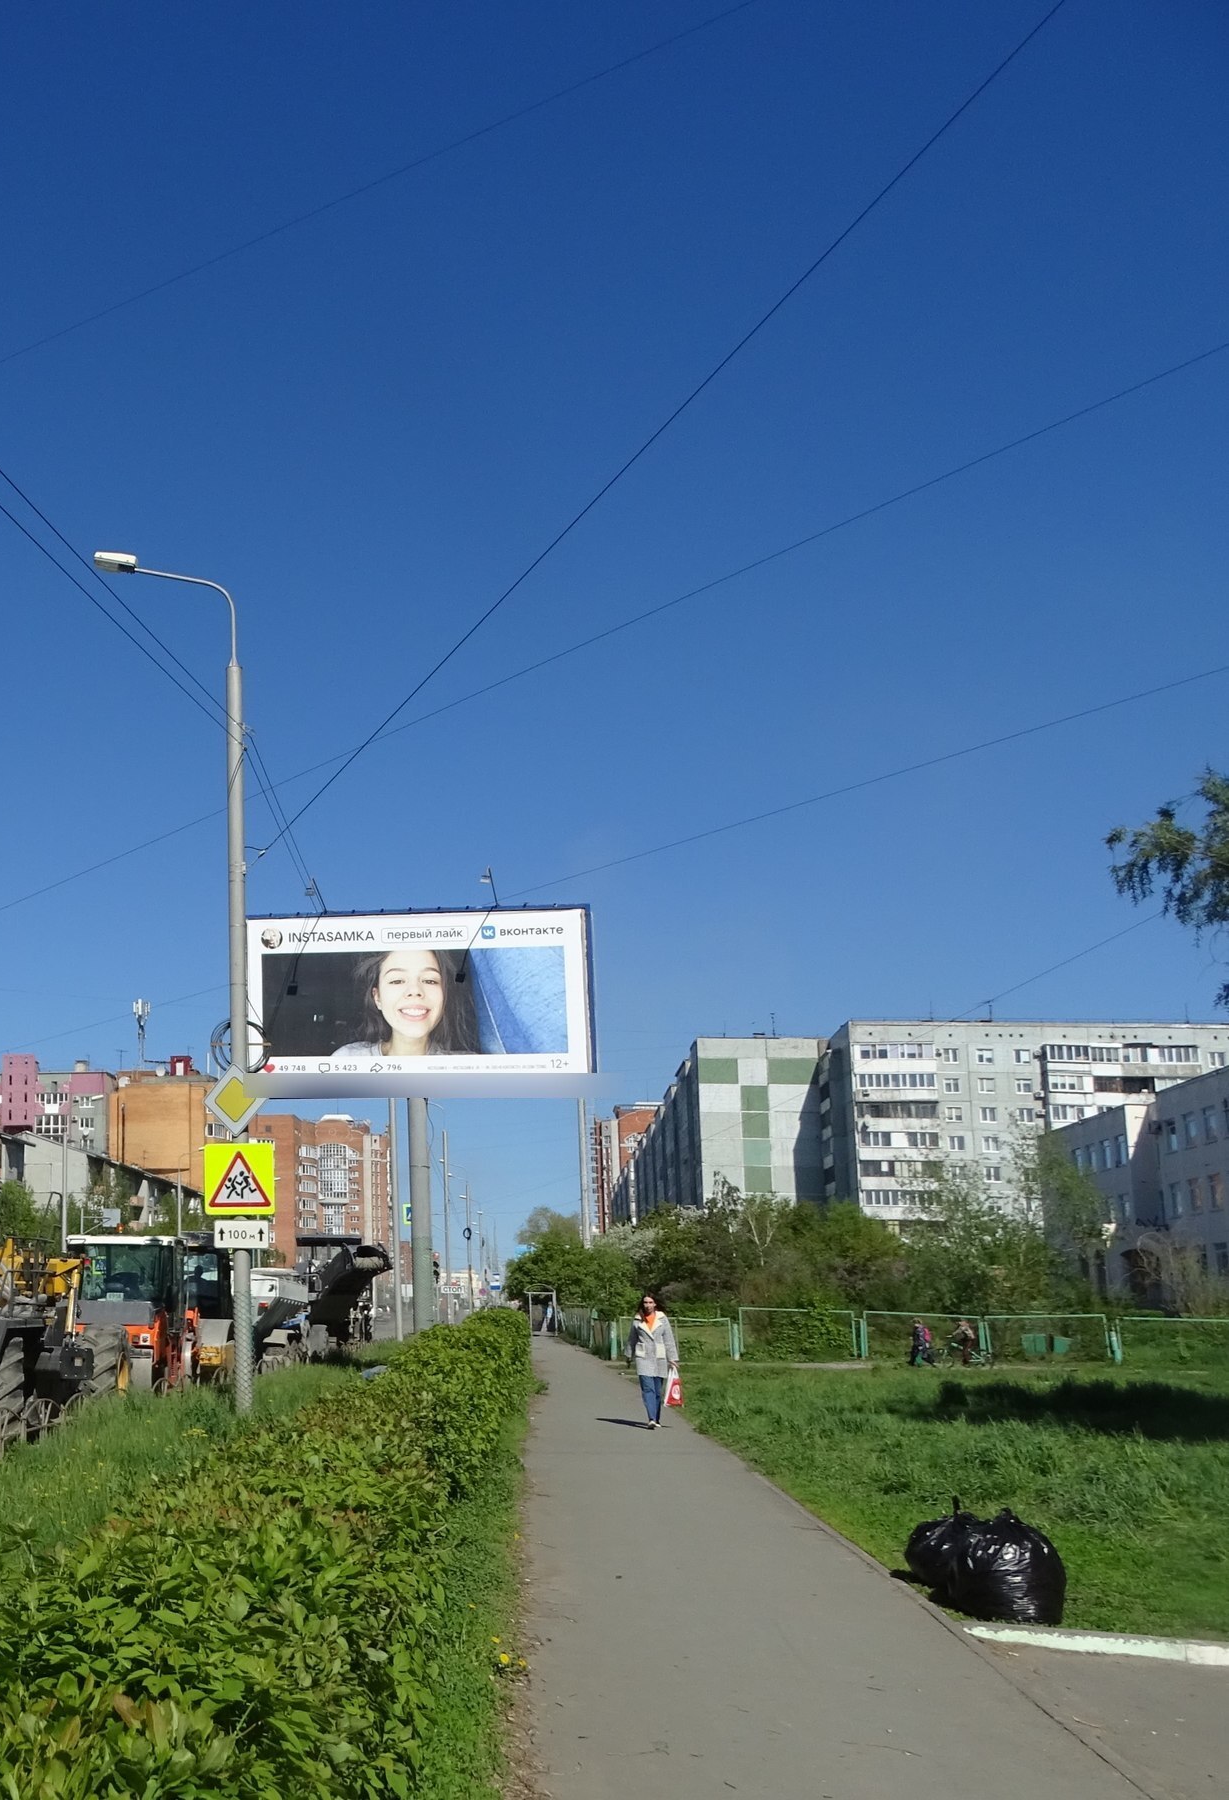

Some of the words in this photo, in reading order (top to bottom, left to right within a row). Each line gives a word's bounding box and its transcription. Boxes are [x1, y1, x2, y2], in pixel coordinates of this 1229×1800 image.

[387, 930, 432, 942] первый
[435, 928, 463, 939] лайк
[499, 925, 564, 936] вконтакте
[288, 931, 374, 943] INSTASAMKA
[550, 1059, 569, 1069] 12+
[228, 1230, 247, 1239] 100
